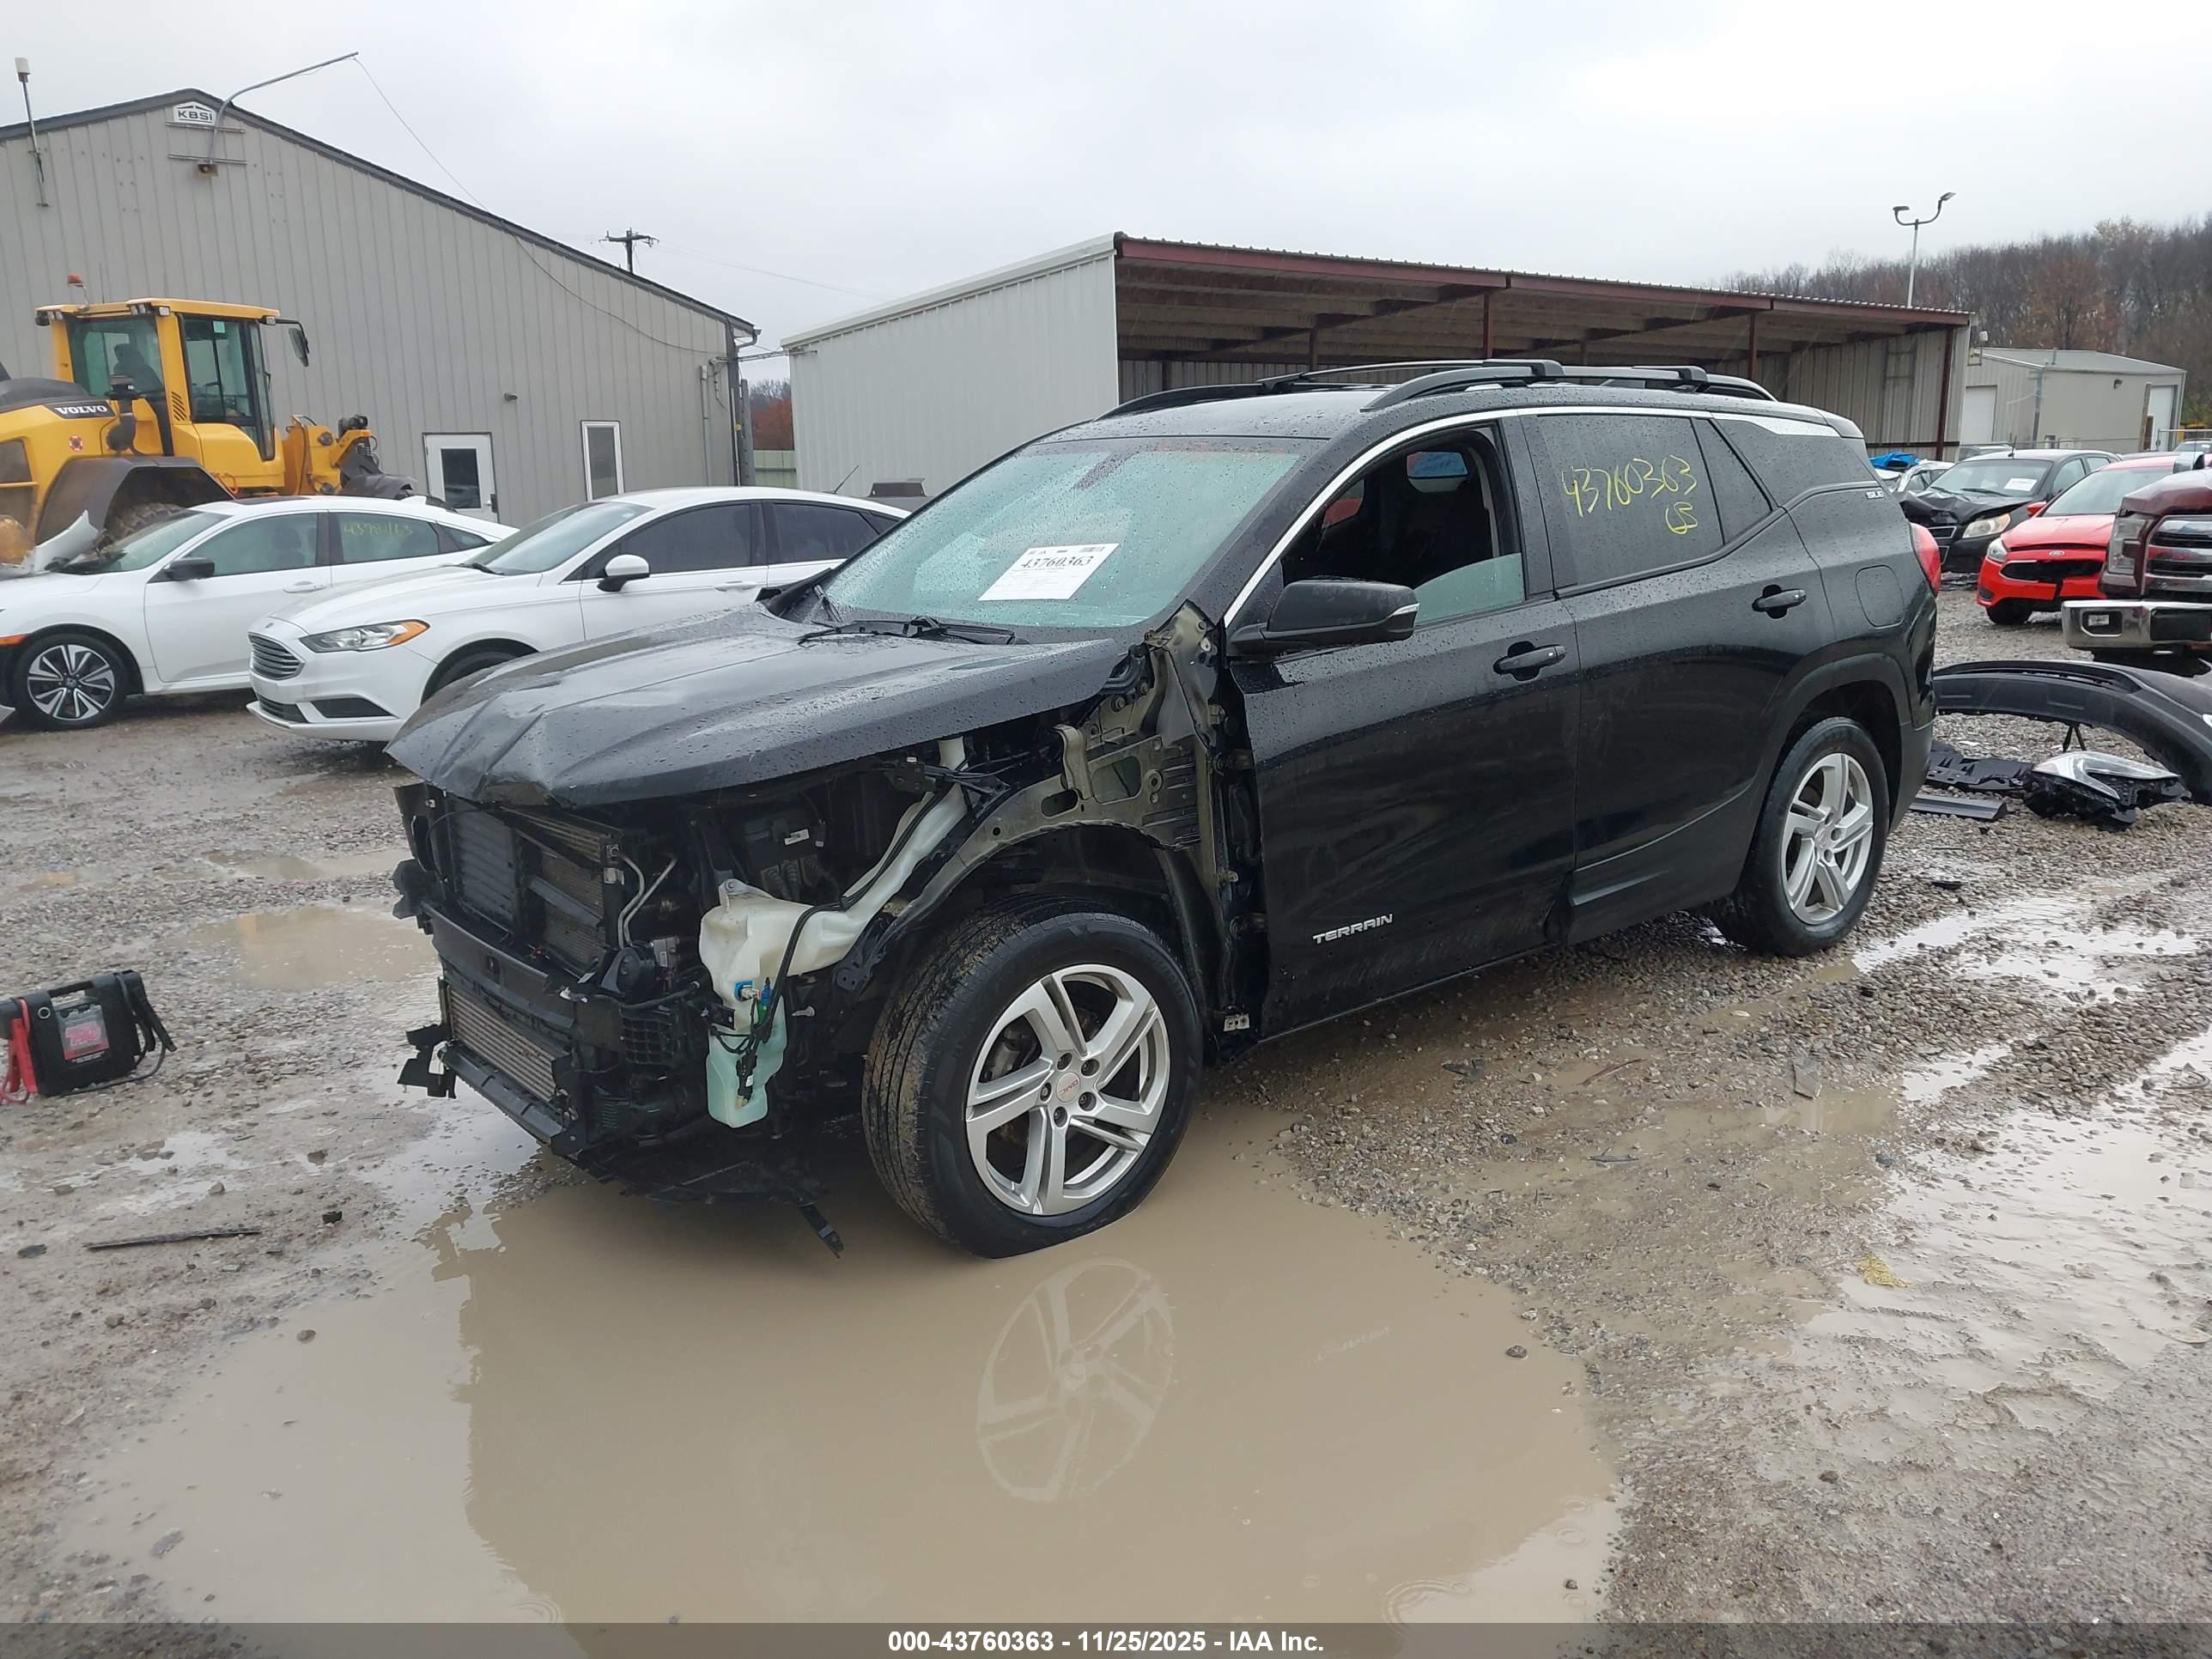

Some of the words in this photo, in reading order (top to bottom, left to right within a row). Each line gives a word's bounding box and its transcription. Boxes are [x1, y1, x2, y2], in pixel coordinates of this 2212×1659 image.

[54, 404, 108, 415] VOLVO
[1561, 454, 1698, 517] 43760363
[1020, 556, 1095, 568] 43760363
[1312, 913, 1394, 945] TERRAIN
[1059, 1079, 1079, 1097] GMC
